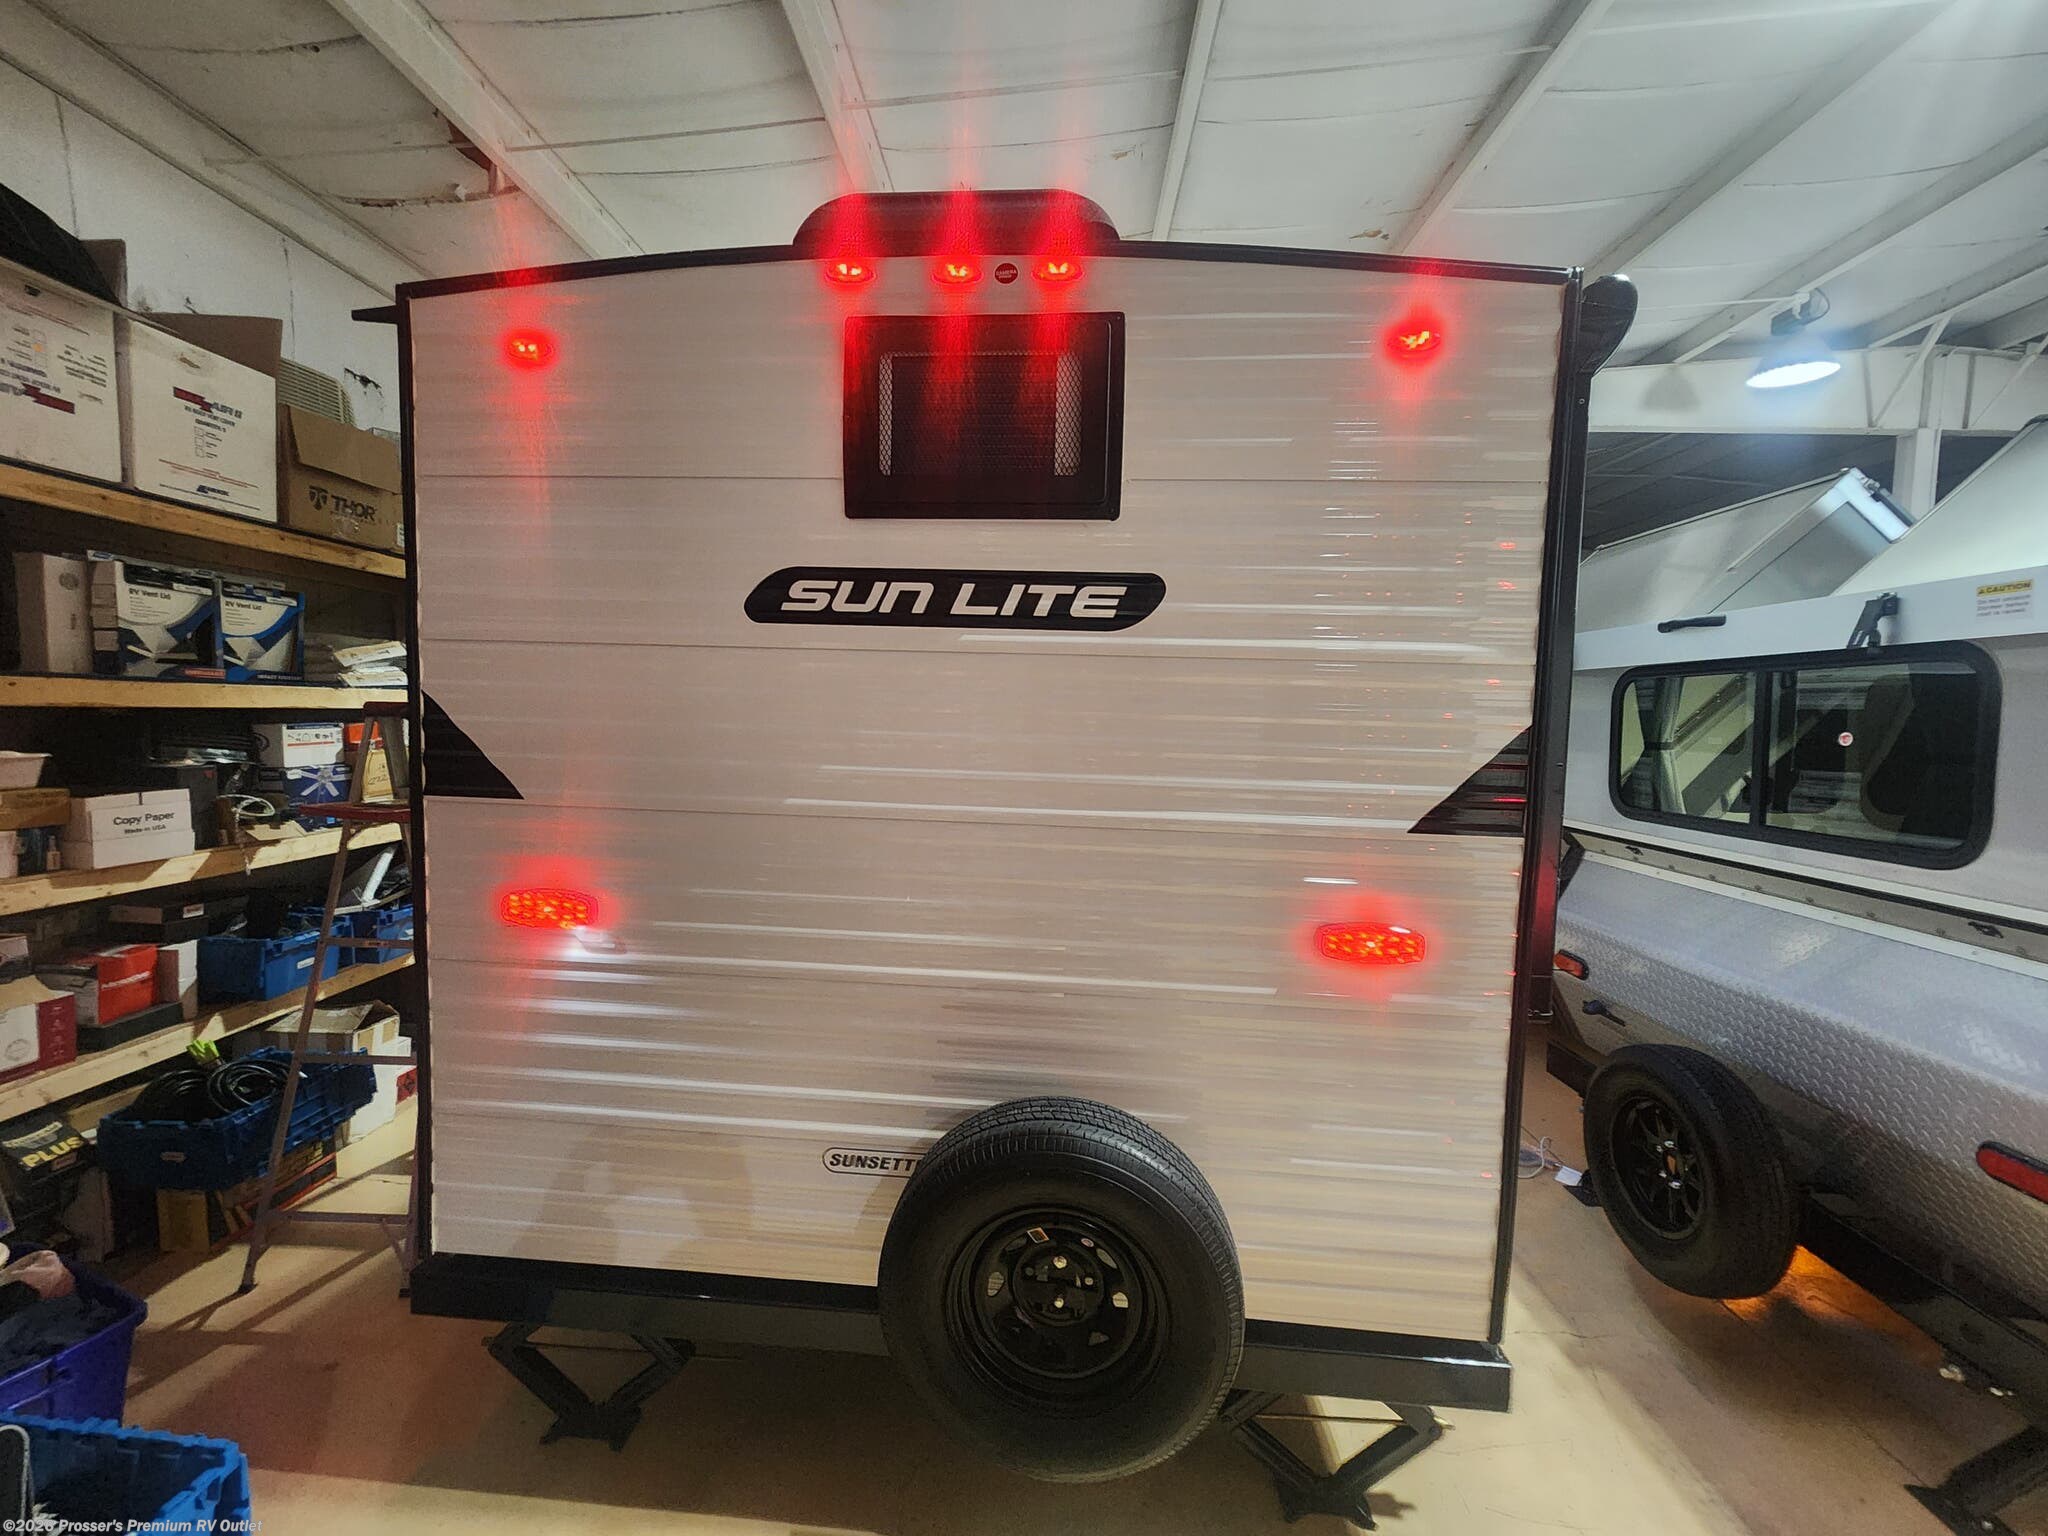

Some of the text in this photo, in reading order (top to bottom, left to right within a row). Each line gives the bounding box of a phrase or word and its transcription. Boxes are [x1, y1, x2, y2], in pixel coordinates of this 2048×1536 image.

[331, 494, 376, 521] THOR
[128, 587, 140, 596] RV
[141, 589, 158, 598] Vent
[1985, 582, 2032, 594] CAUTION
[224, 600, 235, 608] RV
[780, 580, 1128, 618] SUN LITE
[113, 812, 175, 826] Copy Paper
[22, 1136, 84, 1168] PLUS
[829, 1153, 921, 1171] SUNSETT
